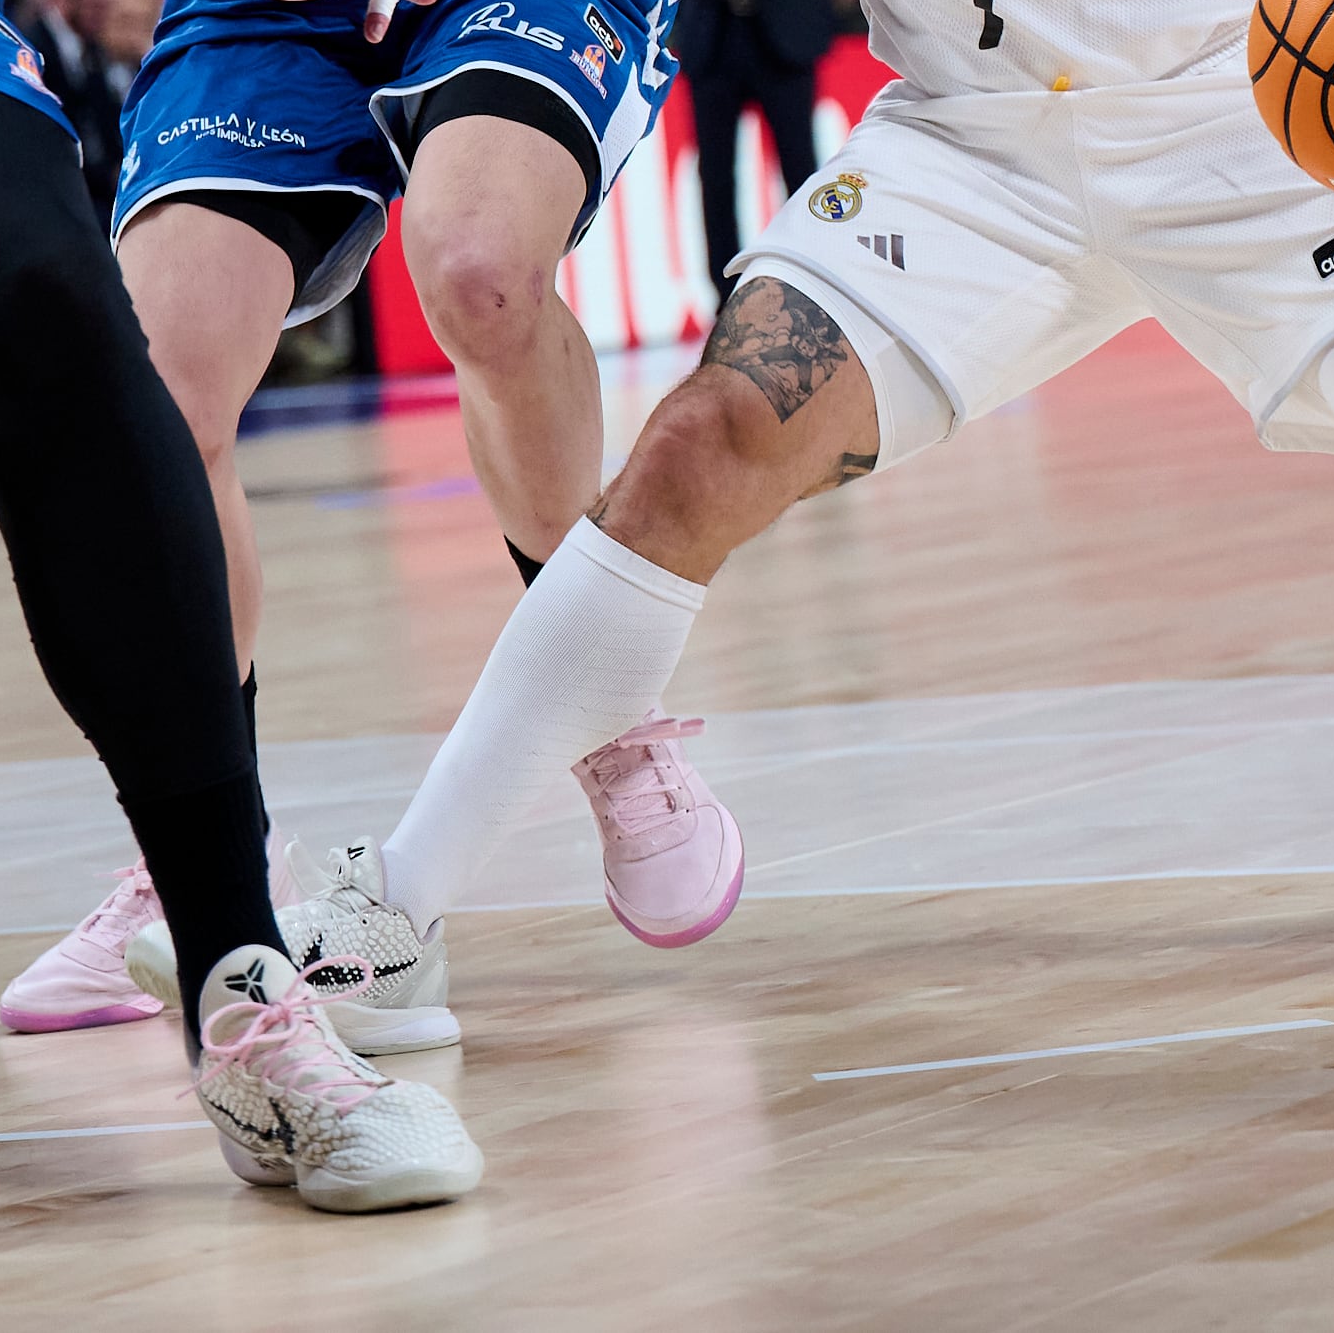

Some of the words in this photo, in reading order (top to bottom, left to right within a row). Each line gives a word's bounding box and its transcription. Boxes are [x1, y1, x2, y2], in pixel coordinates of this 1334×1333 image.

[589, 15, 615, 50] acb
[157, 112, 240, 146] CASTILLA
[246, 117, 257, 137] Y
[261, 124, 307, 148] LEÓN
[217, 127, 266, 148] IMPULSA
